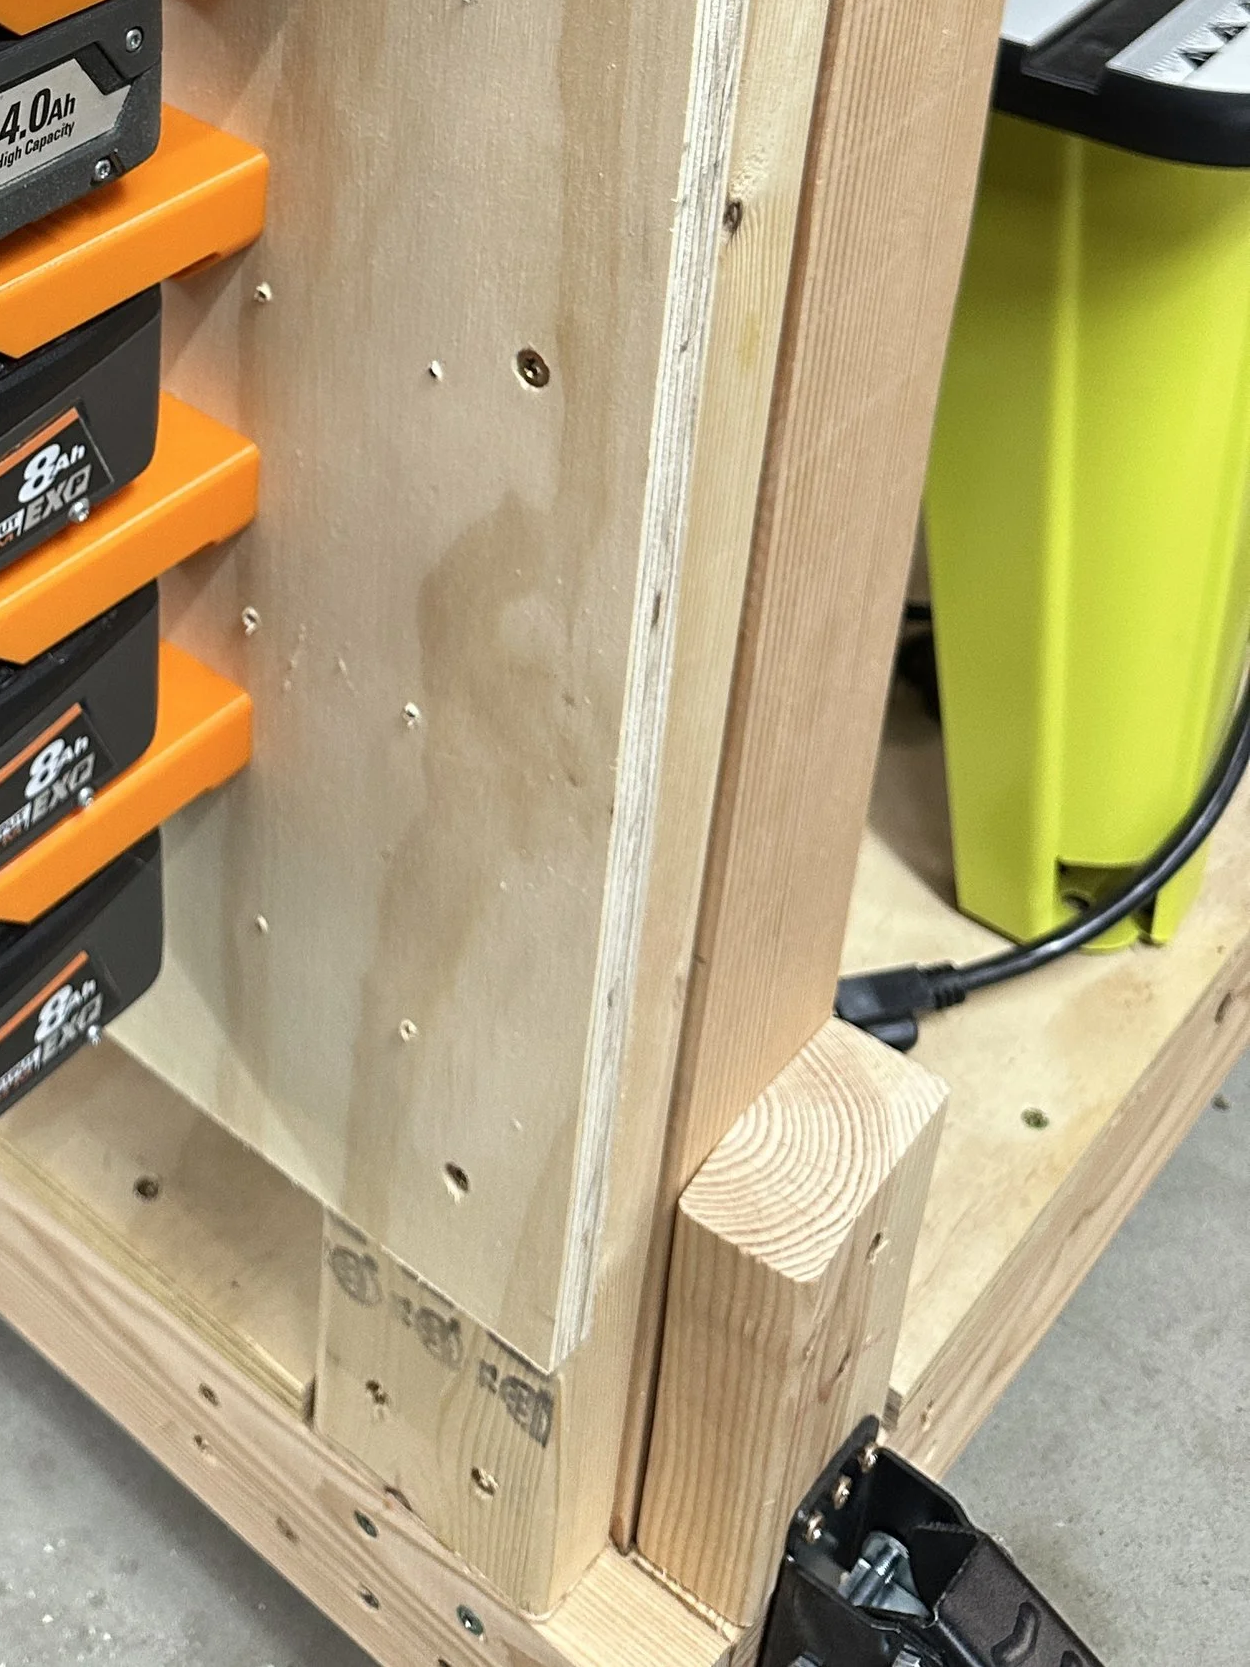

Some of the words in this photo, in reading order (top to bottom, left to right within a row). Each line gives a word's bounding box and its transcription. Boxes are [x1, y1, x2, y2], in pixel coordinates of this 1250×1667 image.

[24, 121, 76, 157] Capacity
[18, 443, 86, 504] 8Ah
[24, 735, 90, 800] 8Ah
